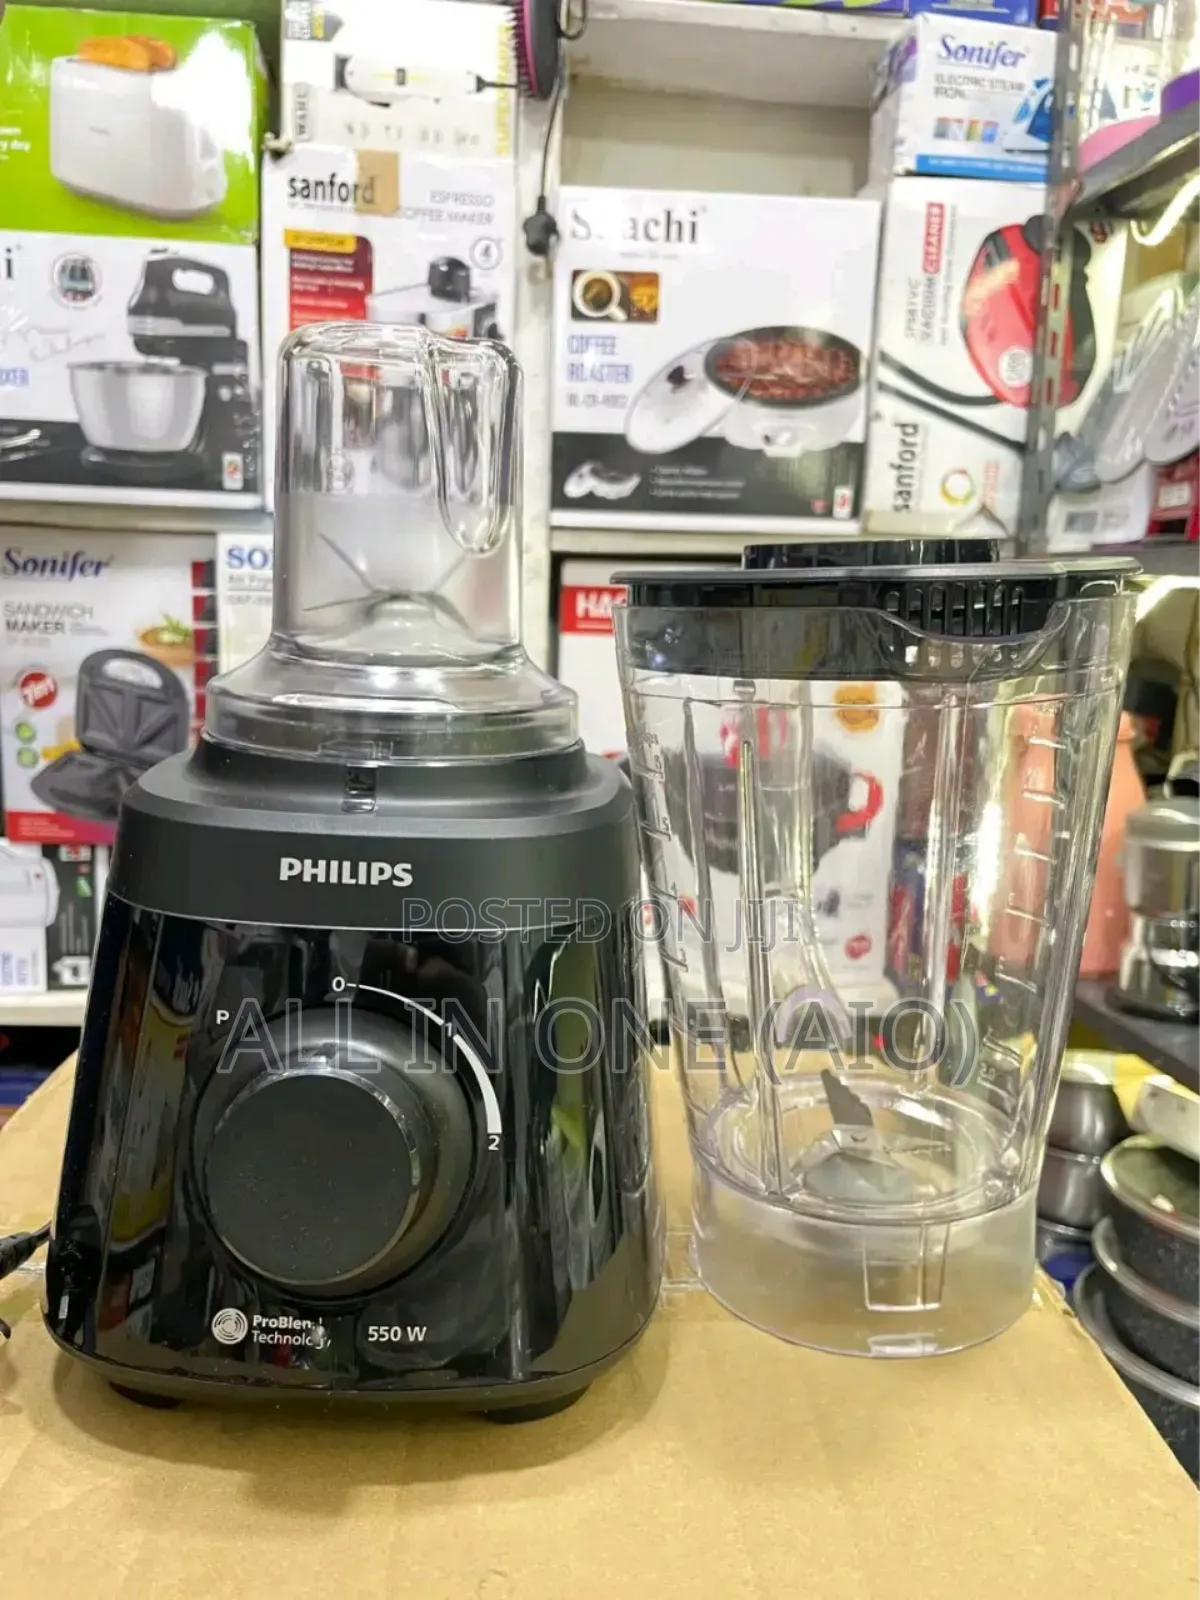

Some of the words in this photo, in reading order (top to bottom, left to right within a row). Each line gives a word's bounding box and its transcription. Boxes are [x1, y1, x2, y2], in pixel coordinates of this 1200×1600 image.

[937, 34, 1025, 70] Sonifer
[288, 172, 375, 204] sanford
[429, 190, 495, 207] ESPRESSO
[399, 205, 442, 222] OFFEE
[570, 208, 698, 244] Sachi
[889, 421, 919, 514] sanford
[2, 546, 109, 581] Sonifer
[226, 544, 273, 570] SO
[3, 601, 94, 619] SANDWICH
[6, 619, 66, 635] MAKER
[279, 857, 413, 887] PHILIPS
[332, 976, 345, 993] 0
[215, 1010, 230, 1025] P
[488, 1135, 500, 1151] 2
[367, 1326, 401, 1342] 550
[407, 1326, 427, 1341] W
